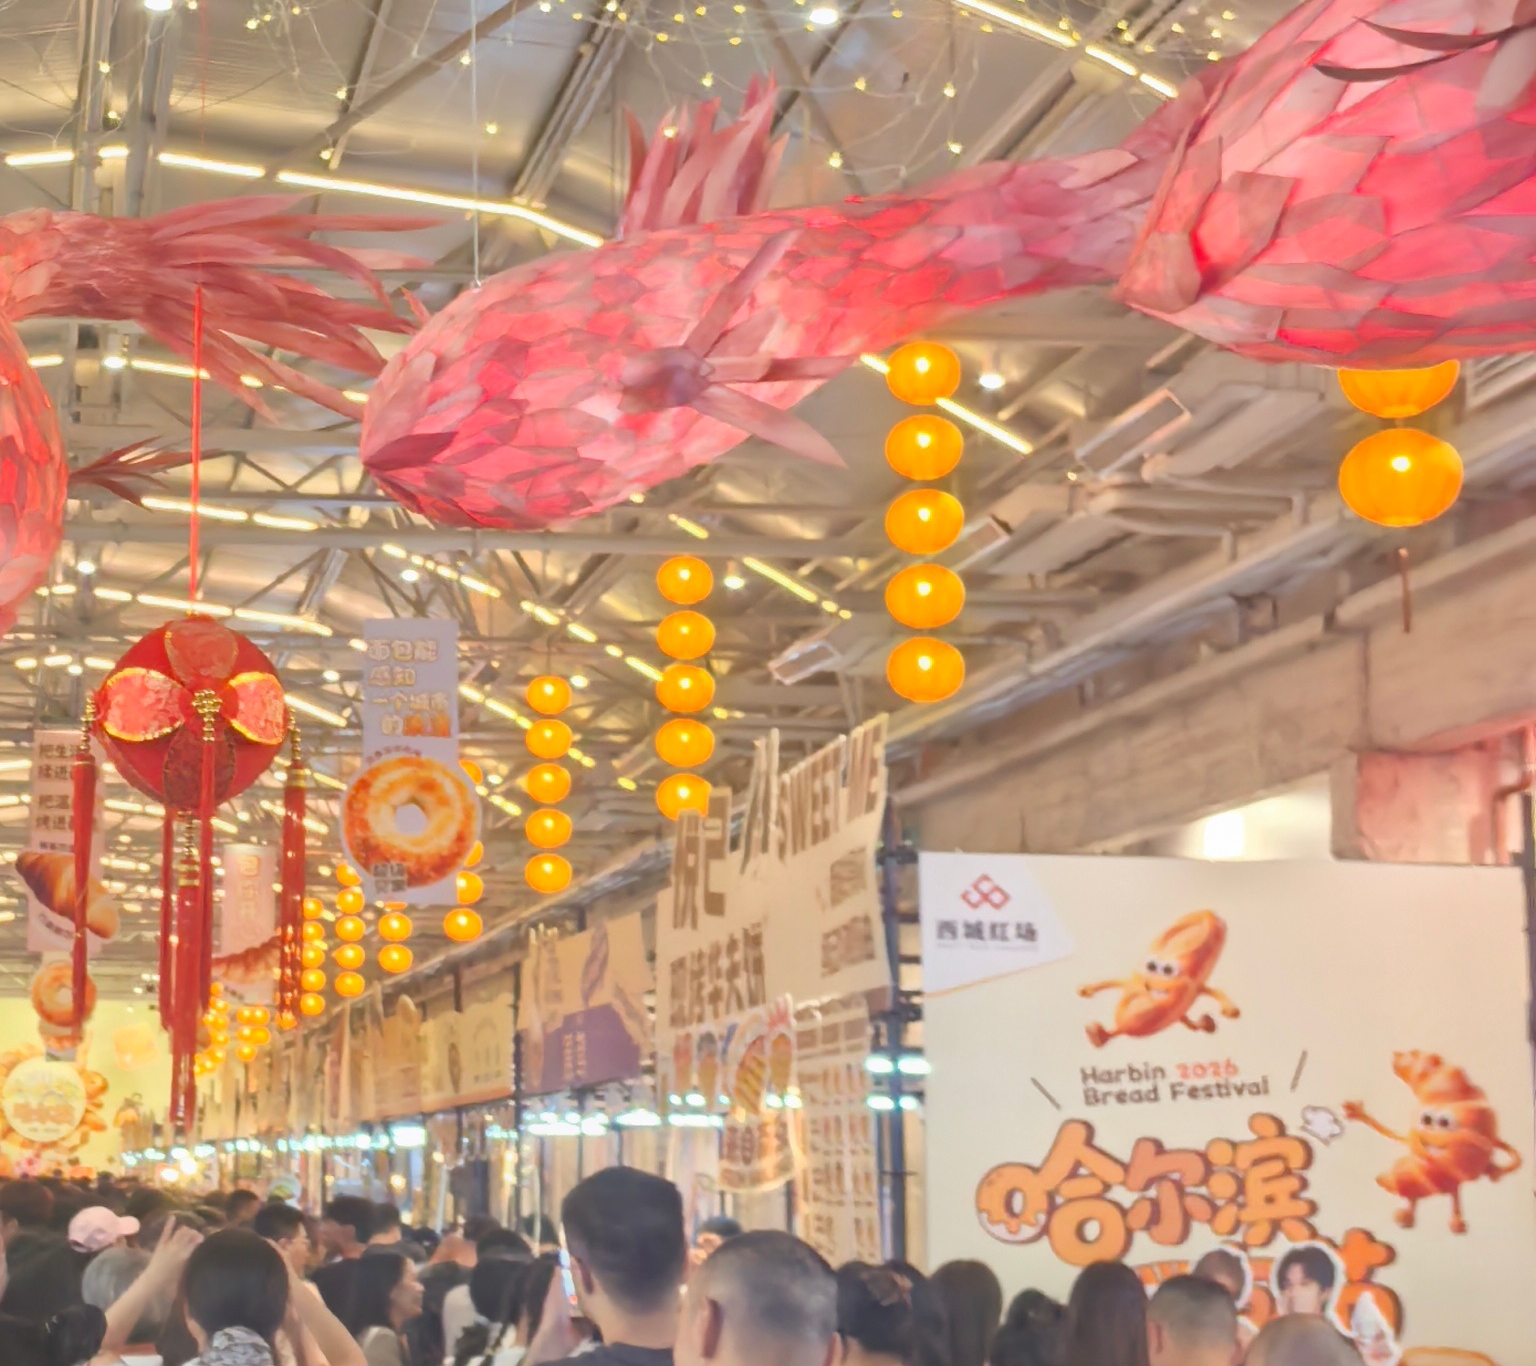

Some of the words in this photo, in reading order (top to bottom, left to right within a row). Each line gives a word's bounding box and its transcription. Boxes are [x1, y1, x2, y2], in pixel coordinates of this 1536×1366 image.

[937, 920, 1039, 943] 西城红场
[1080, 1062, 1167, 1085] Harbin
[1175, 1058, 1240, 1080] 2026
[1083, 1084, 1161, 1107] Bread
[1169, 1075, 1270, 1102] Festival
[976, 1112, 1318, 1267] 哈尔滨
